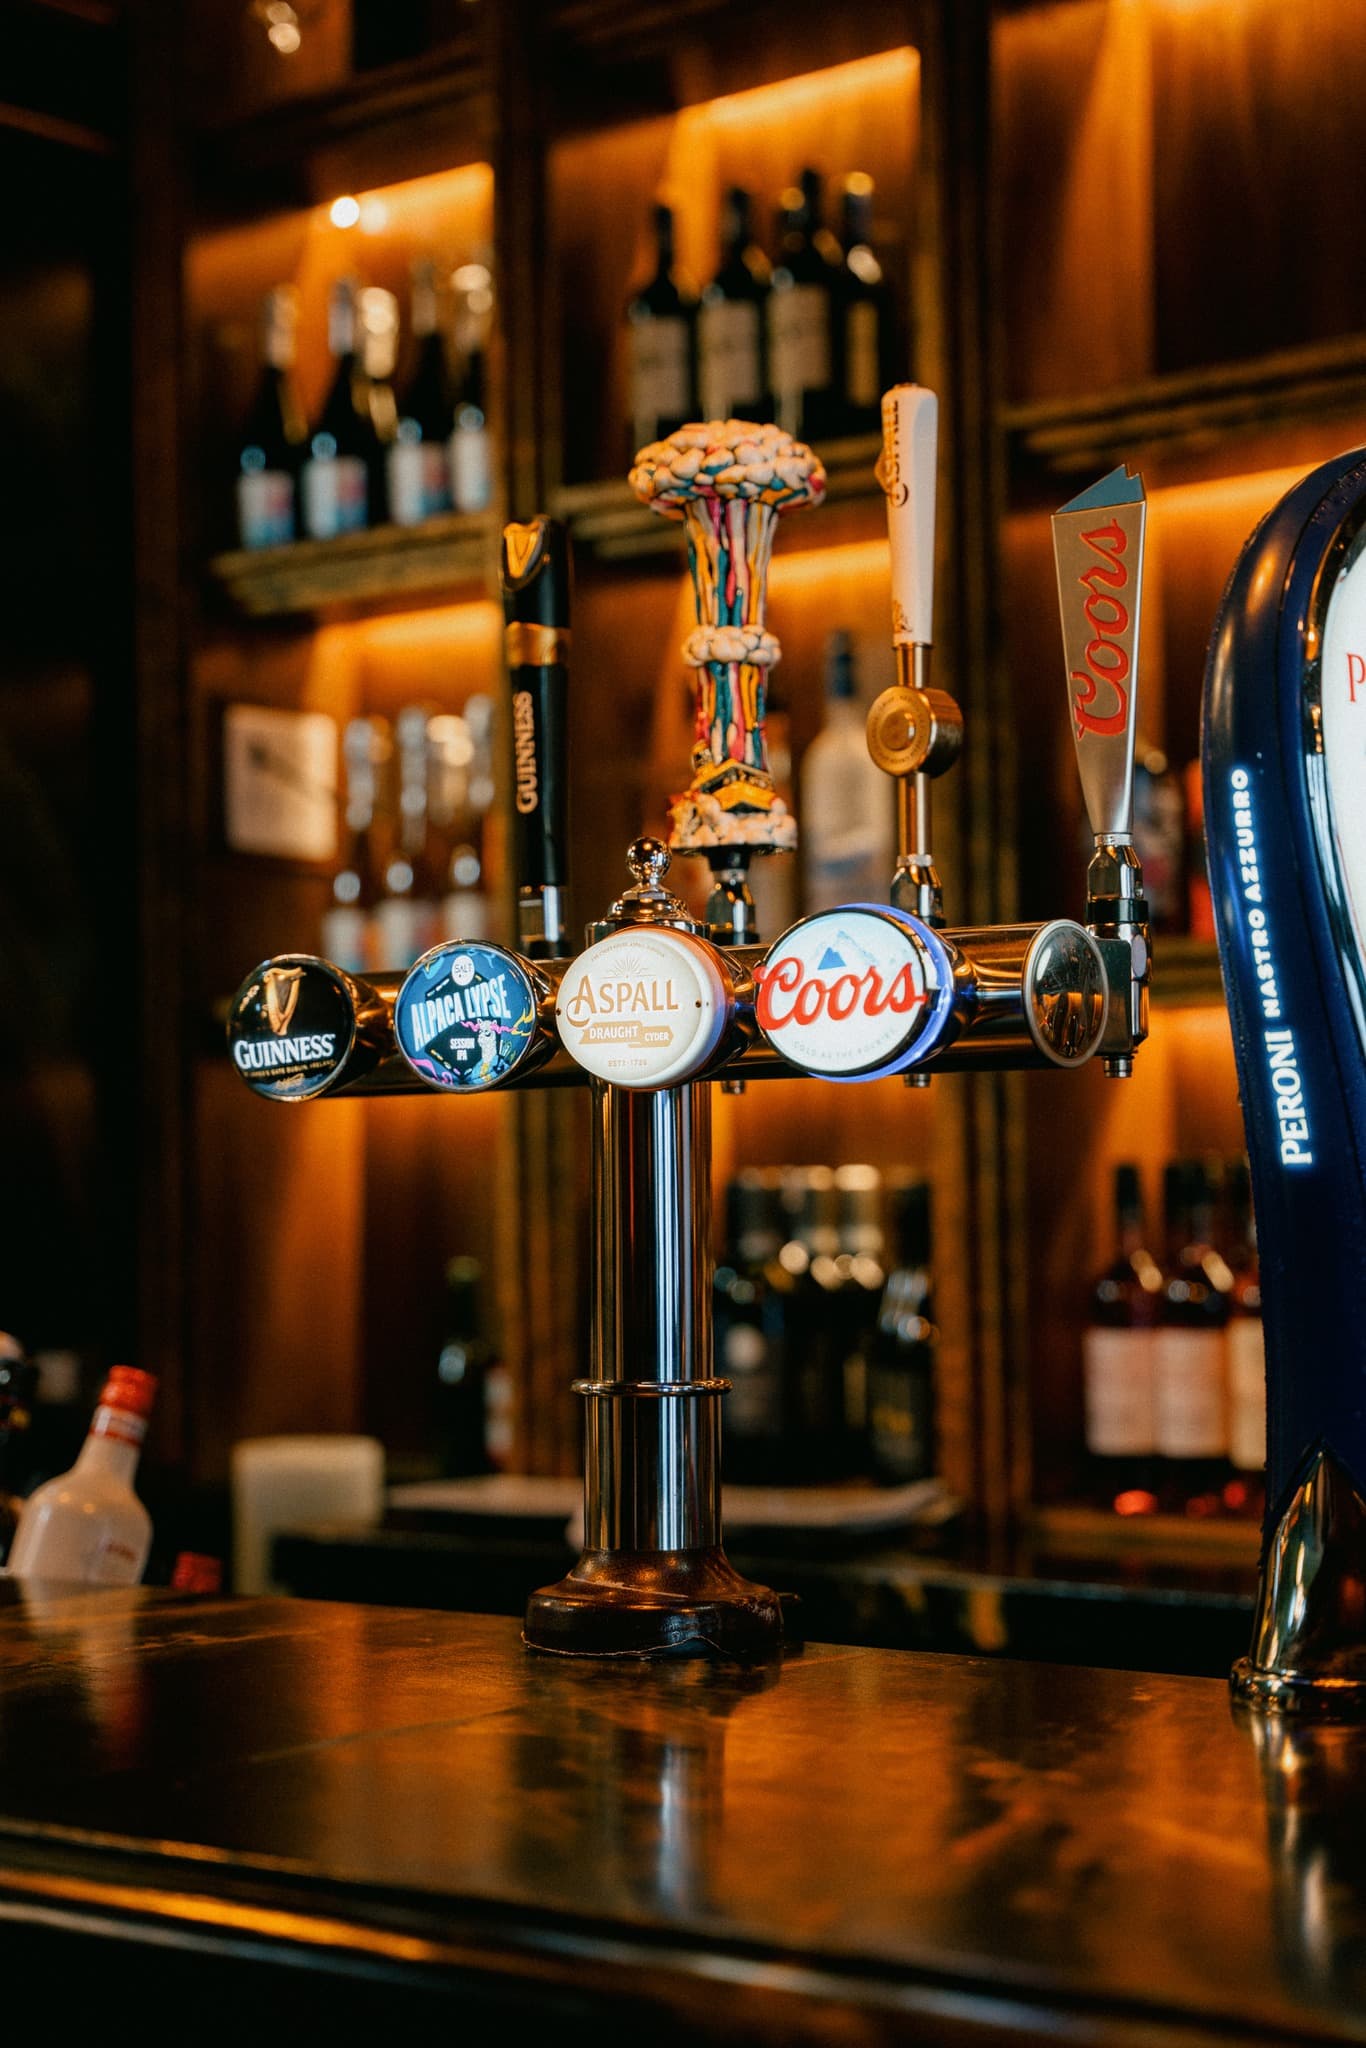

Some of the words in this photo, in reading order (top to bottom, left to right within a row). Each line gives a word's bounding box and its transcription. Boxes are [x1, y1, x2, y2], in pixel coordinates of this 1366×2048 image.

[1070, 518, 1129, 741] Coors
[513, 690, 538, 815] GUINNESS
[1231, 767, 1263, 902] AZZURRO
[455, 962, 473, 974] SALT
[753, 957, 928, 1031] Coors
[1248, 909, 1281, 1018] NASTRO
[566, 975, 679, 1027] ASPALL
[589, 1026, 639, 1040] DRAUGHT
[644, 1031, 670, 1042] CYDER
[234, 1034, 335, 1070] GUINNESS
[457, 1050, 468, 1061] IPA
[1265, 1030, 1312, 1166] PERONI
